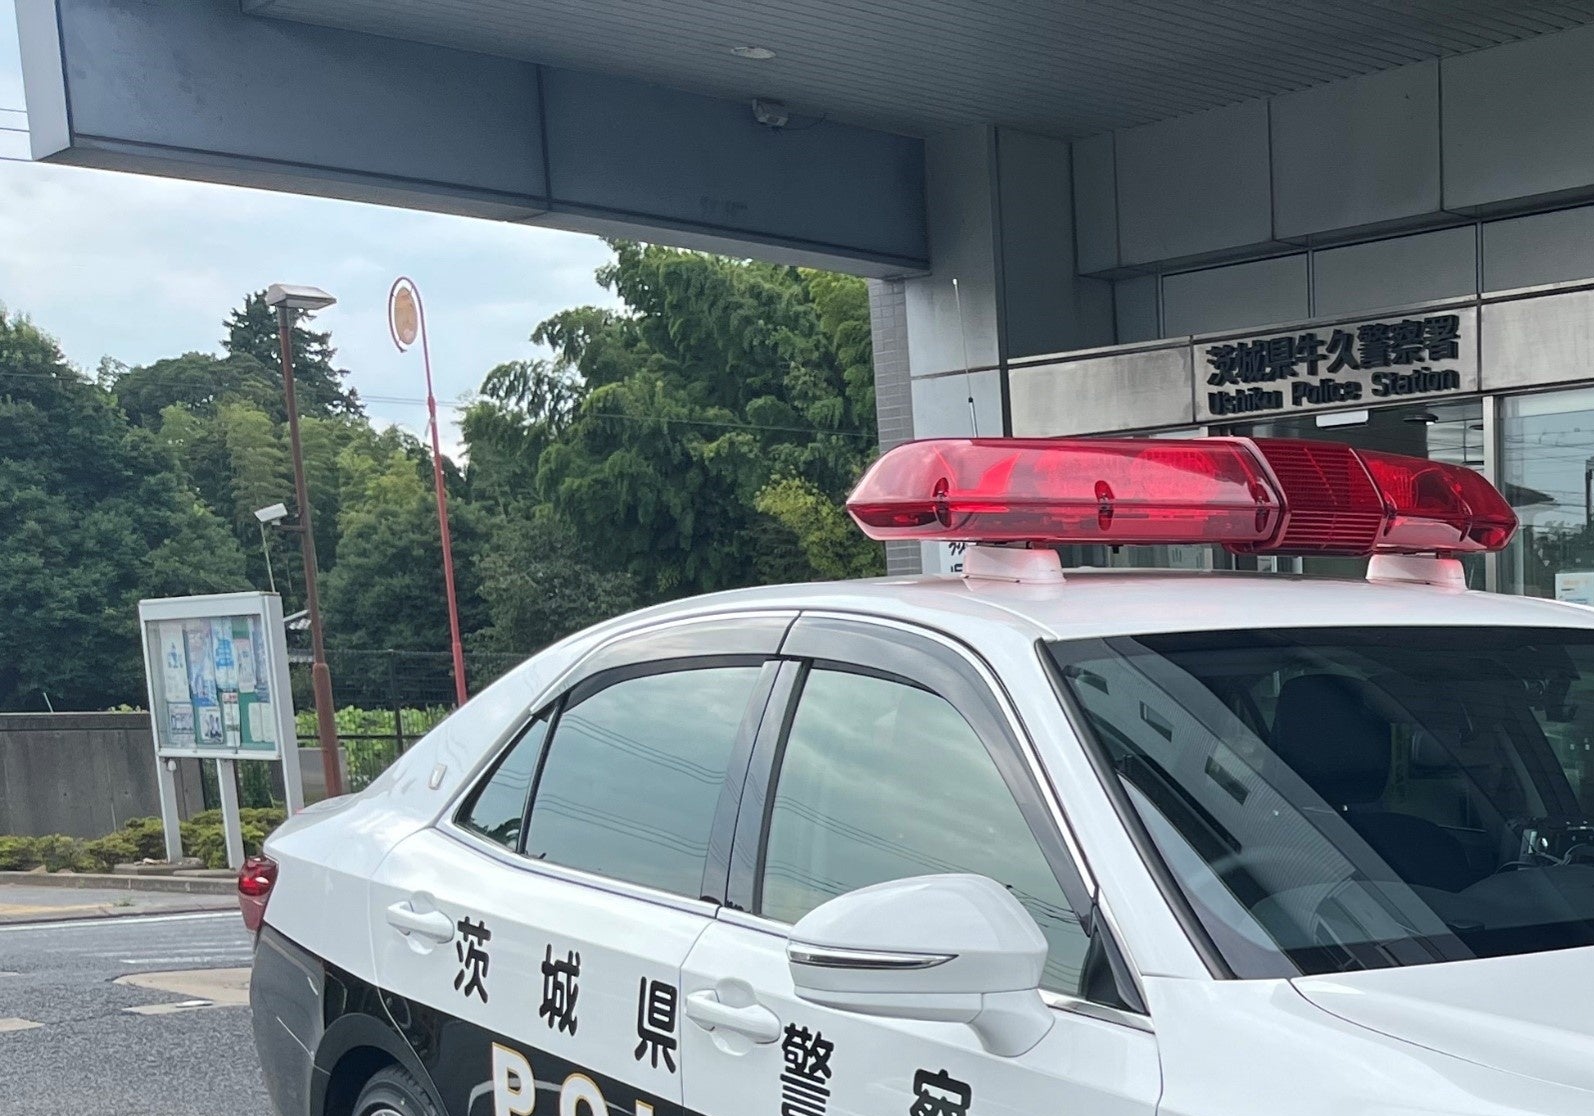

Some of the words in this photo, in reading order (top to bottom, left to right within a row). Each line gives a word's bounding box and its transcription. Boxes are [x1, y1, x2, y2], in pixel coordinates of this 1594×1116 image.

[1206, 314, 1461, 387] 茨城県牛久警察署
[1207, 387, 1284, 415] Ushiku
[1291, 378, 1362, 406] Police
[1371, 366, 1461, 397] Station
